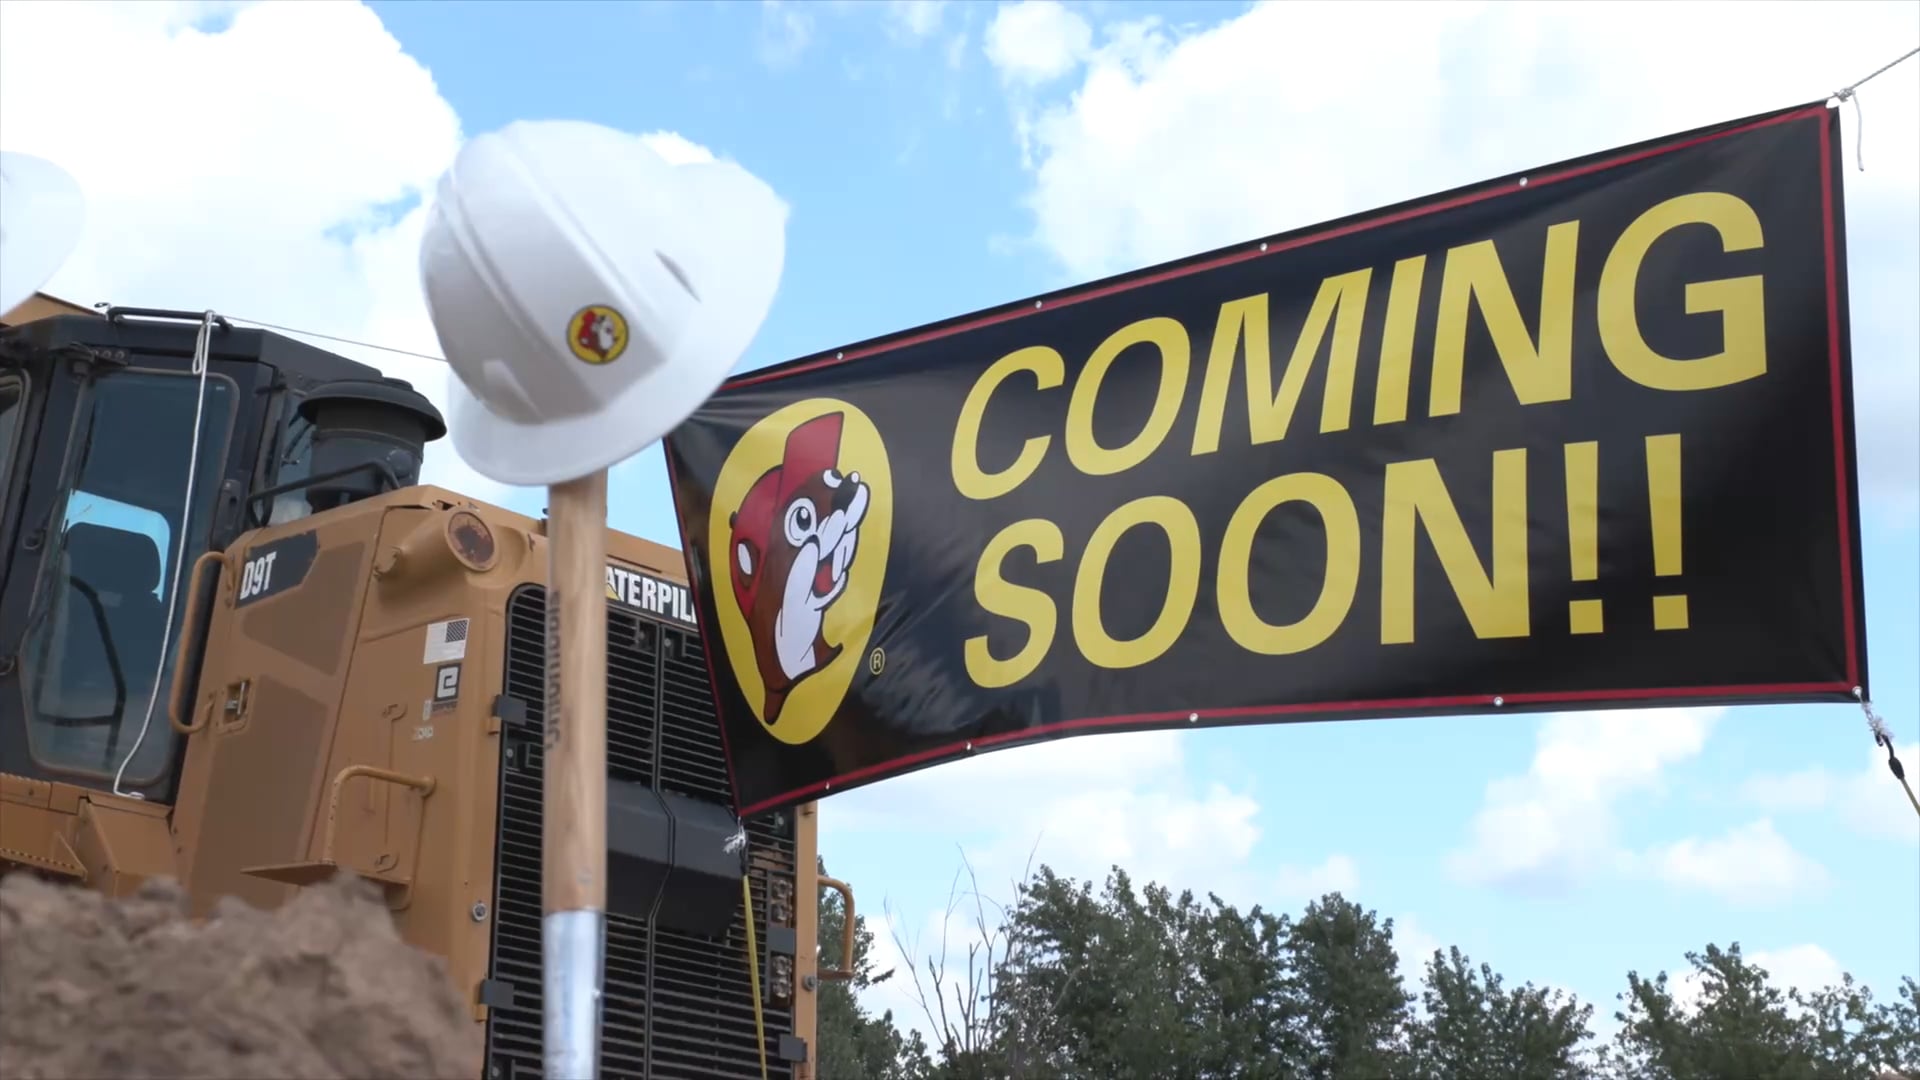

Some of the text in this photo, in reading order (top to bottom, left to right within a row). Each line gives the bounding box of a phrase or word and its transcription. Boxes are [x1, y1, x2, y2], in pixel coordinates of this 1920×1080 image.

[952, 191, 1768, 500] COMING
[239, 551, 277, 600] D9T
[606, 566, 698, 624] ATERPIL
[963, 433, 1690, 690] SOON!!
